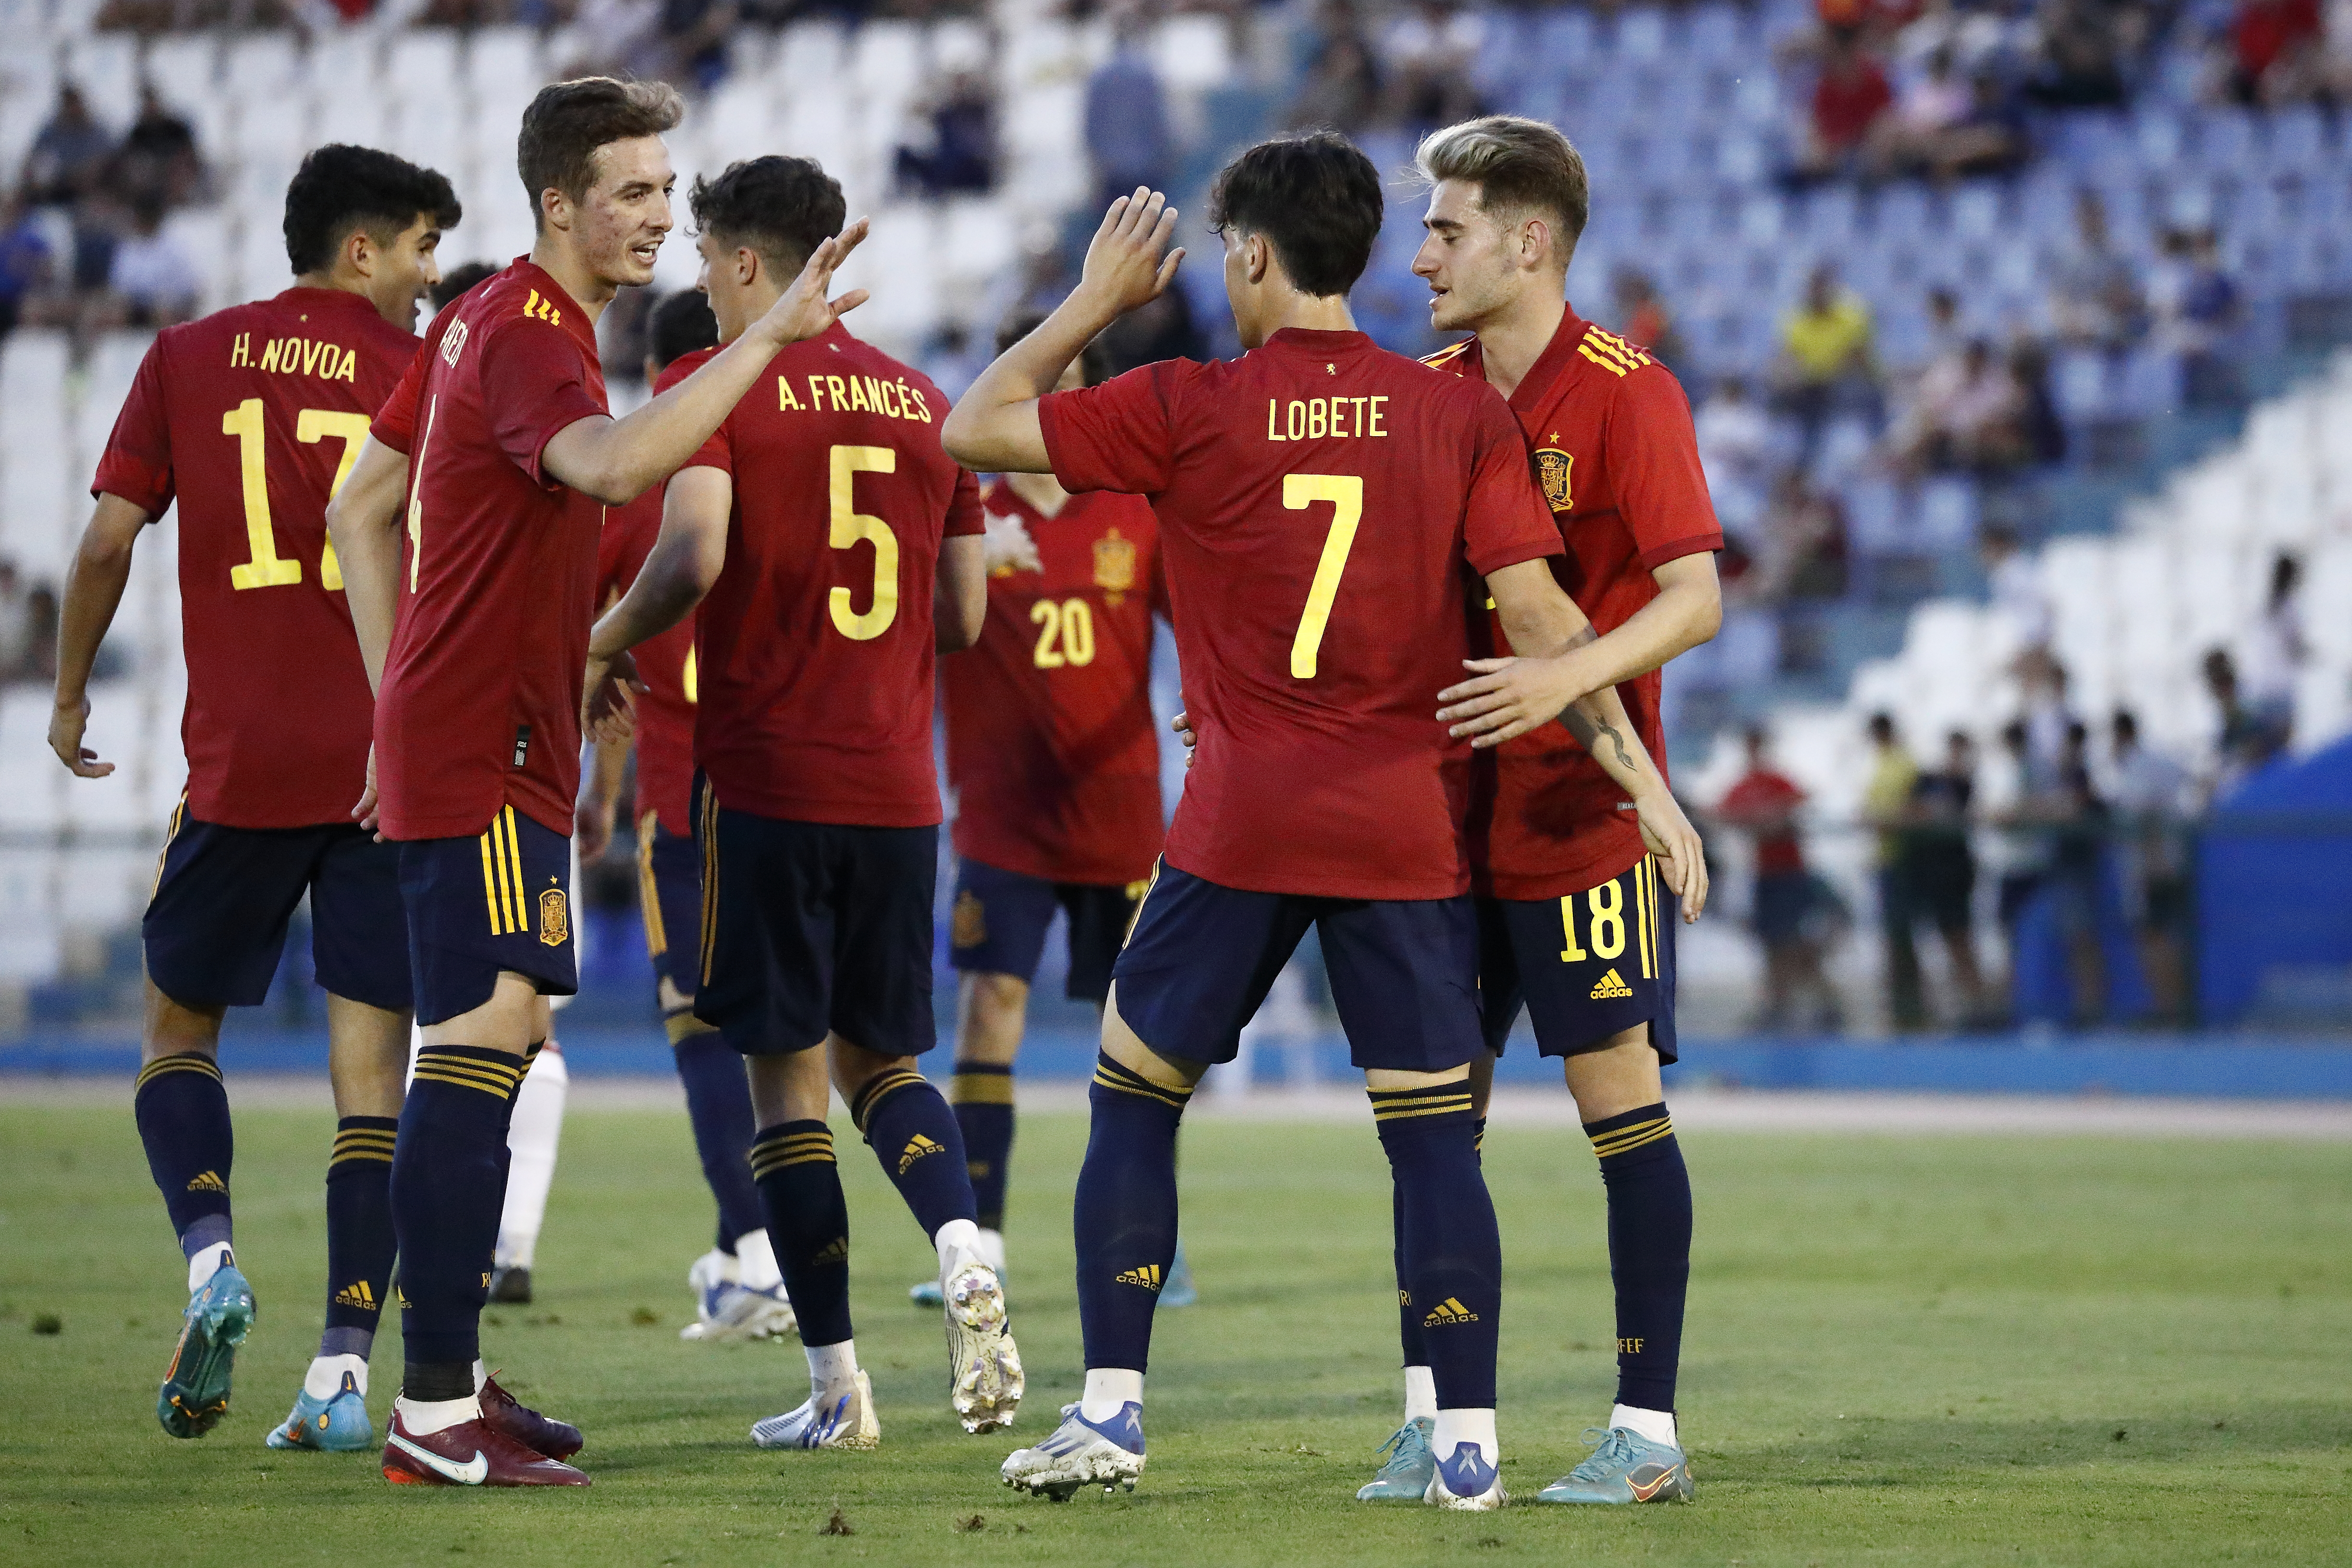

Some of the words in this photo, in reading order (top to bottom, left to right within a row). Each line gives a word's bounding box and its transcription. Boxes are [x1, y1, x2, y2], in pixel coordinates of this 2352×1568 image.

[231, 331, 256, 368] H.
[260, 336, 355, 383] NOVOA
[778, 375, 806, 411] A.
[808, 374, 931, 423] FRANCÉS
[1268, 395, 1389, 441] LOBETE
[222, 398, 372, 591] 17
[829, 444, 899, 640] 5
[1282, 474, 1363, 679] 7
[1030, 598, 1095, 668] 20
[1560, 878, 1626, 962] 18
[1590, 987, 1633, 1000] adidas
[899, 1144, 945, 1175] adidas
[335, 1295, 377, 1311] adidas
[1424, 1313, 1479, 1328] adidas
